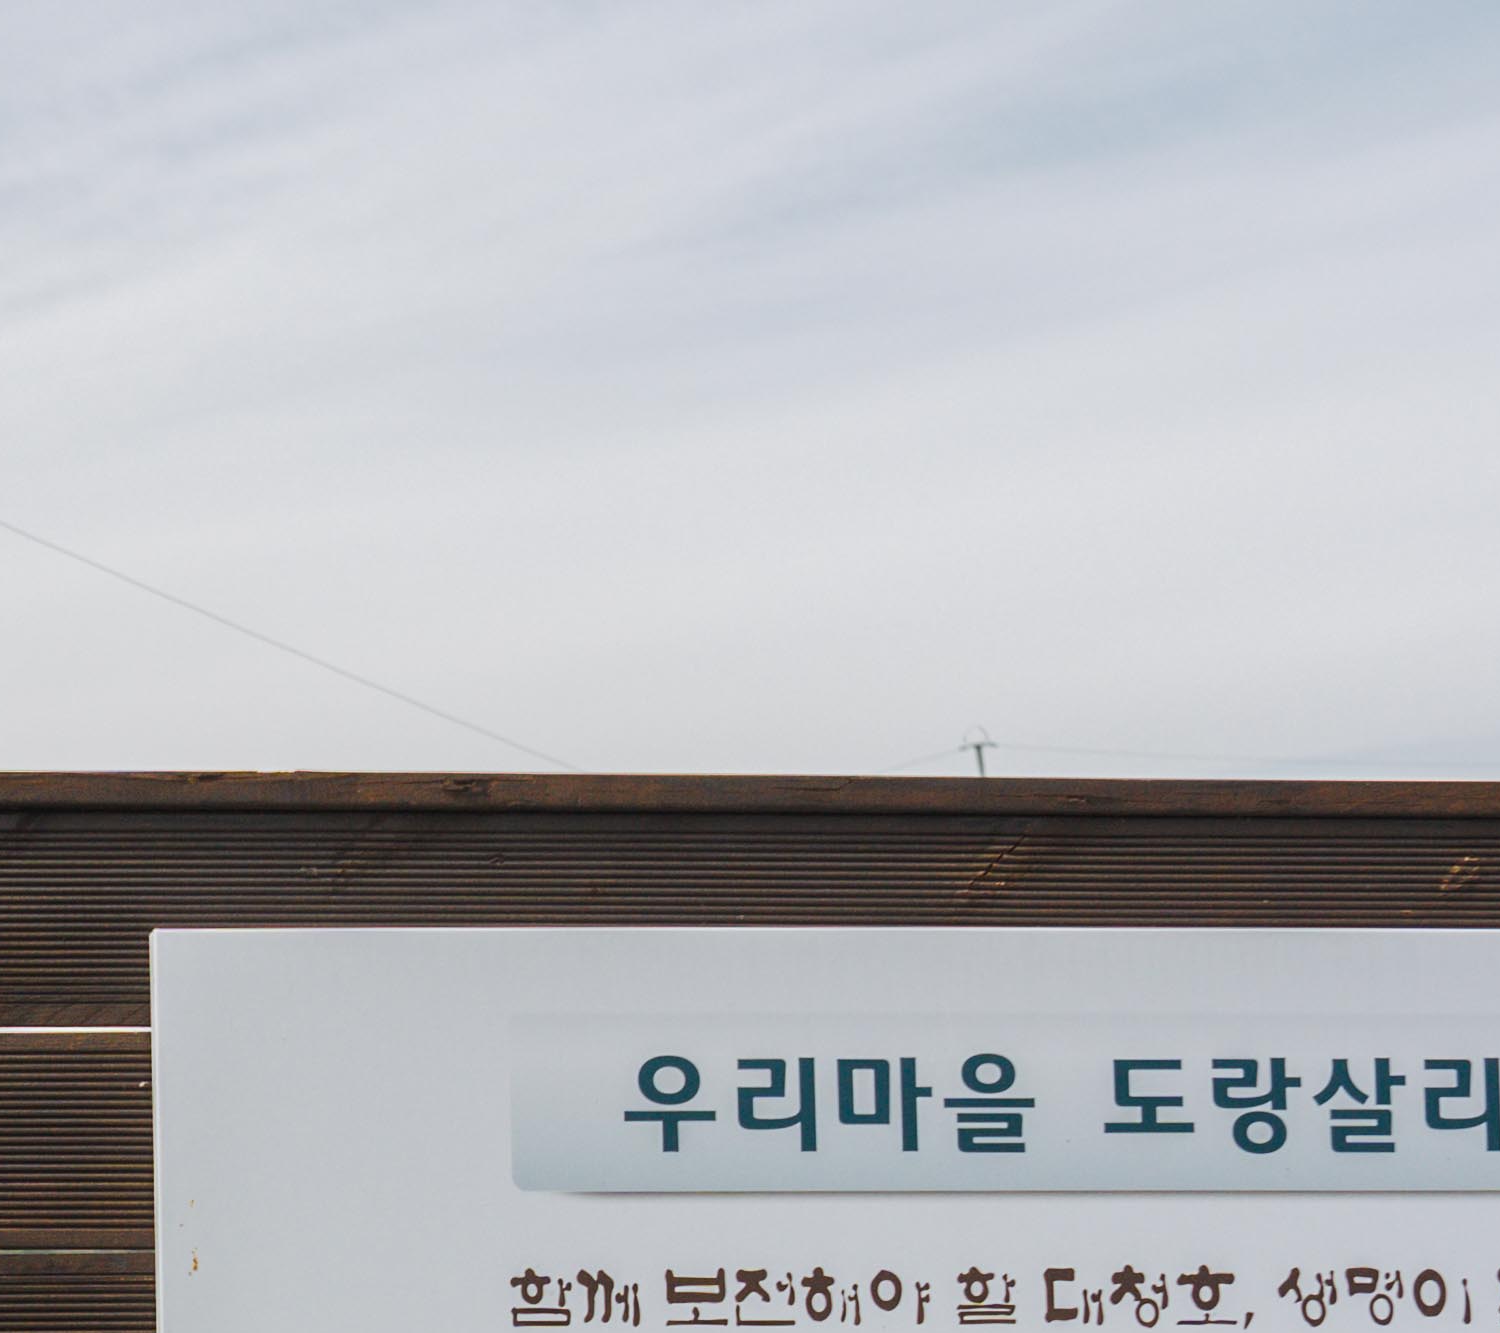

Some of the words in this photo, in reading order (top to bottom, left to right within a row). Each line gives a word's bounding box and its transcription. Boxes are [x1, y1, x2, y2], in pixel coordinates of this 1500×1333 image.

[623, 1053, 1036, 1154] 우리마을
[509, 1267, 641, 1328] 함께
[664, 1266, 931, 1327] 보전해야
[956, 1266, 1017, 1325] 할
[1043, 1264, 1255, 1330] 대청호,
[1277, 1267, 1472, 1328] 생명이
